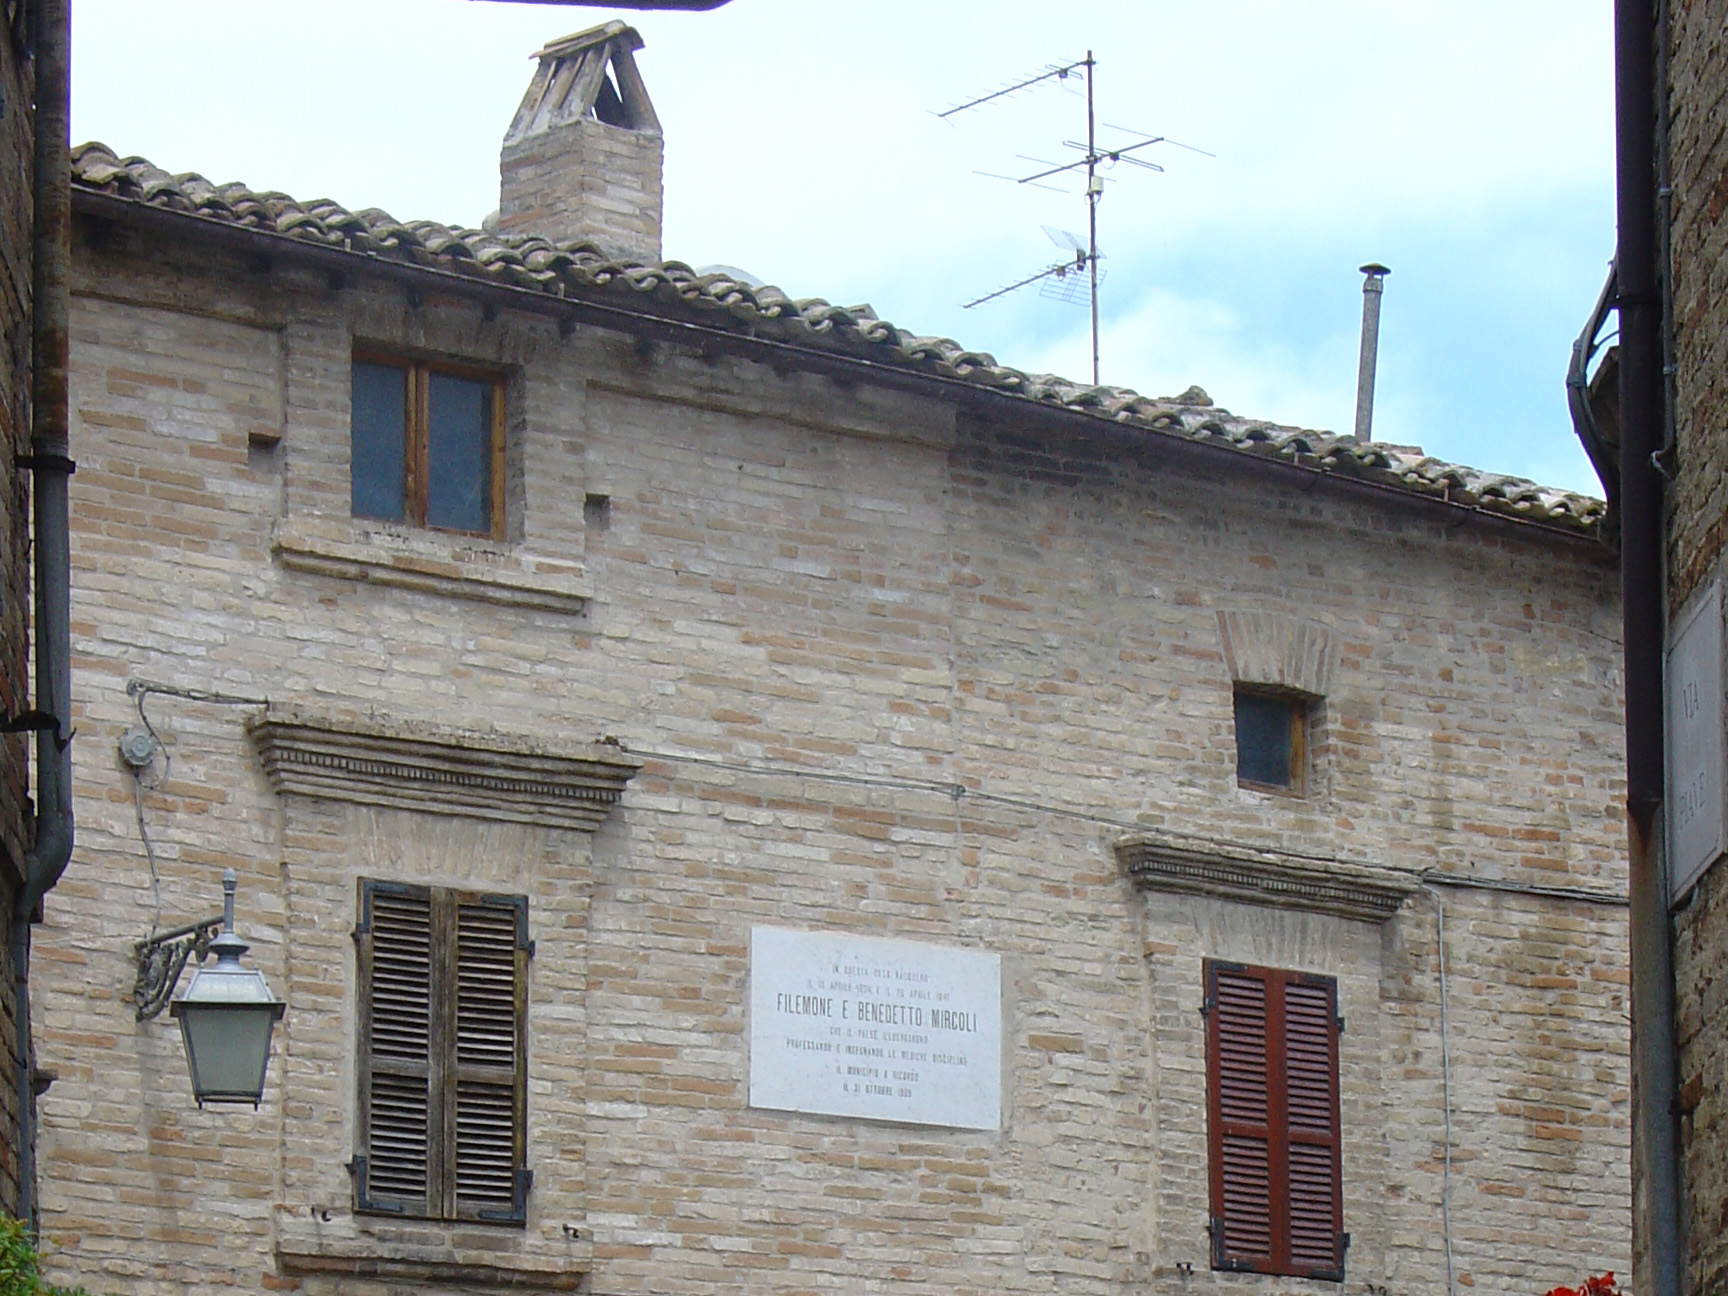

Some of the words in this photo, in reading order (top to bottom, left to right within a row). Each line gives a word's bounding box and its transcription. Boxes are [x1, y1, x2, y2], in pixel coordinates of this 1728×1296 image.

[1683, 680, 1699, 719] VIA
[1680, 772, 1704, 831] PIAVE
[832, 964, 839, 974] IN
[844, 965, 868, 977] QUESTA
[776, 992, 834, 1018] FILEMONE
[842, 999, 849, 1019] E
[858, 1000, 922, 1027] BENEDETTO
[931, 1008, 977, 1032] MIRCOLI
[829, 1026, 841, 1036] CHE
[858, 1028, 878, 1040] PAESE
[786, 1038, 832, 1052] PROFESSANDO
[836, 1043, 841, 1053] E
[845, 1044, 883, 1058] INSEGNANDO
[888, 1049, 896, 1059] LE
[847, 1065, 879, 1078] MUNICIPIO
[884, 1069, 888, 1079] A
[892, 1070, 919, 1082] RICORDO
[843, 1082, 849, 1093] IL
[865, 1084, 892, 1096] OTTOBRE
